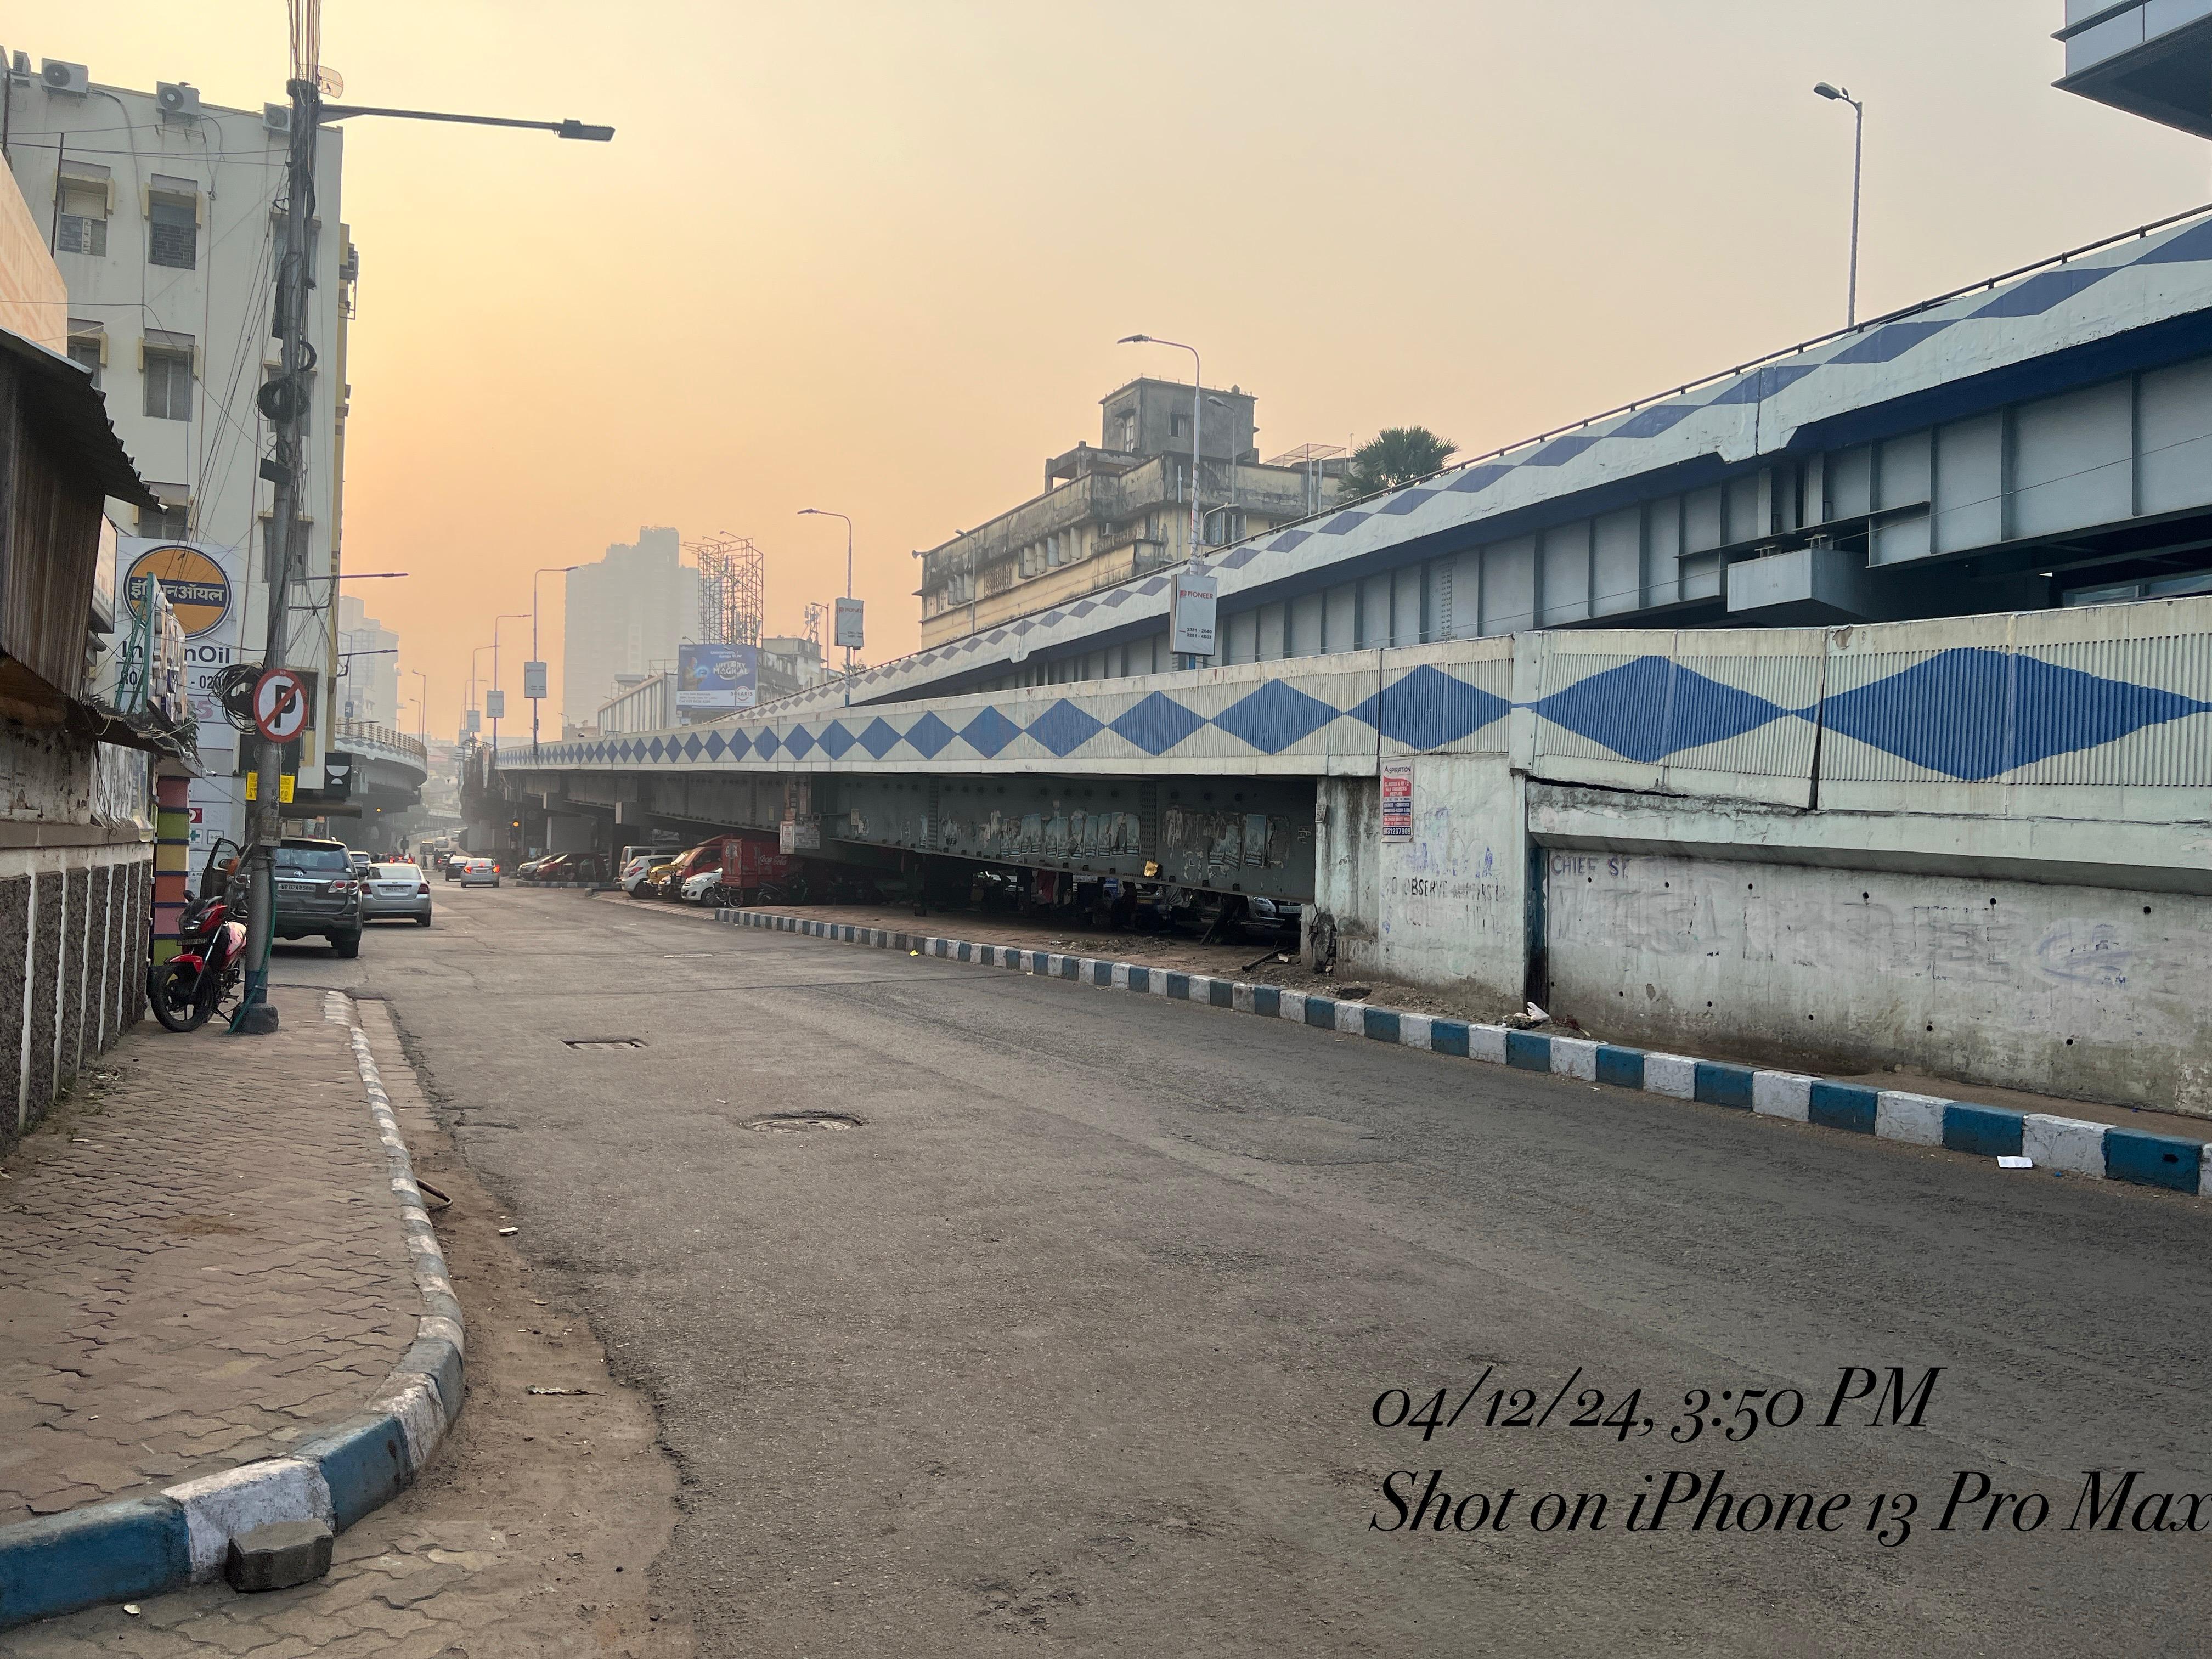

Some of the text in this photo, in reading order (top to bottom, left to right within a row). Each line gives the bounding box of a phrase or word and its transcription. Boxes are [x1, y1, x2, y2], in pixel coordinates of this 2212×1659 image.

[1188, 591, 1214, 600] PIONEER
[122, 641, 230, 664] InnOil
[713, 667, 749, 675] MAGICAL
